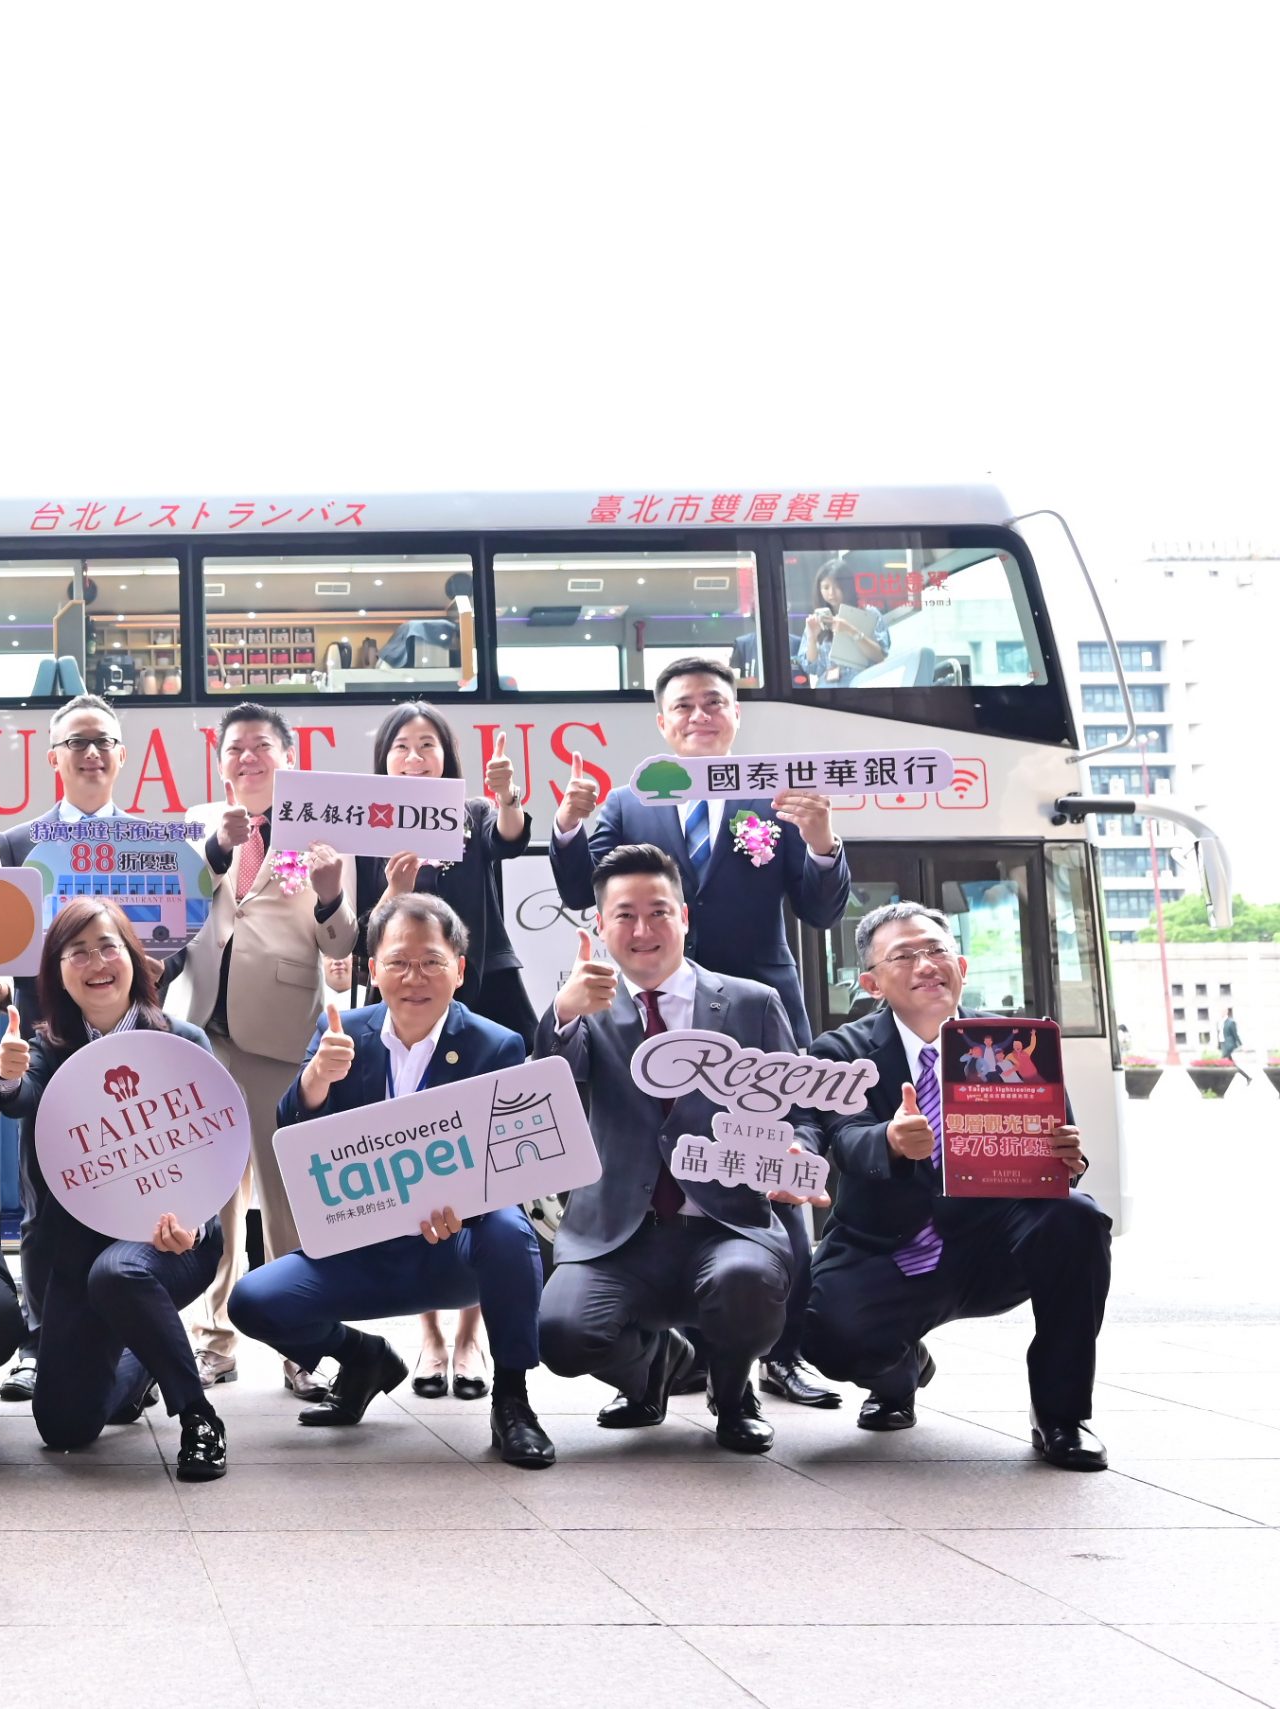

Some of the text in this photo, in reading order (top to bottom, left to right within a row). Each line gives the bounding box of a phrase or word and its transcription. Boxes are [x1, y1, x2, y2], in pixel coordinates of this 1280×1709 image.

[29, 500, 367, 532] 台北レストランバス
[588, 491, 860, 524] 臺北市雙層餐車
[707, 755, 938, 792] 國泰世華銀行
[278, 800, 365, 826] 星展銀行
[396, 804, 459, 832] DBS
[31, 821, 205, 842] 持萬事達卡預定餐車
[640, 1036, 872, 1113] Regent
[68, 1081, 207, 1155] TAIPEI
[722, 1123, 786, 1142] TAIPEI
[945, 1114, 1061, 1134] 雙層觀光巴士
[61, 1106, 238, 1190] RESTAURANT
[330, 1110, 463, 1162] undiscovered
[136, 1164, 184, 1196] BUS
[309, 1134, 475, 1206] taipei
[681, 1146, 820, 1190] 晶華酒店
[326, 1198, 397, 1225] 你所未見的台北
